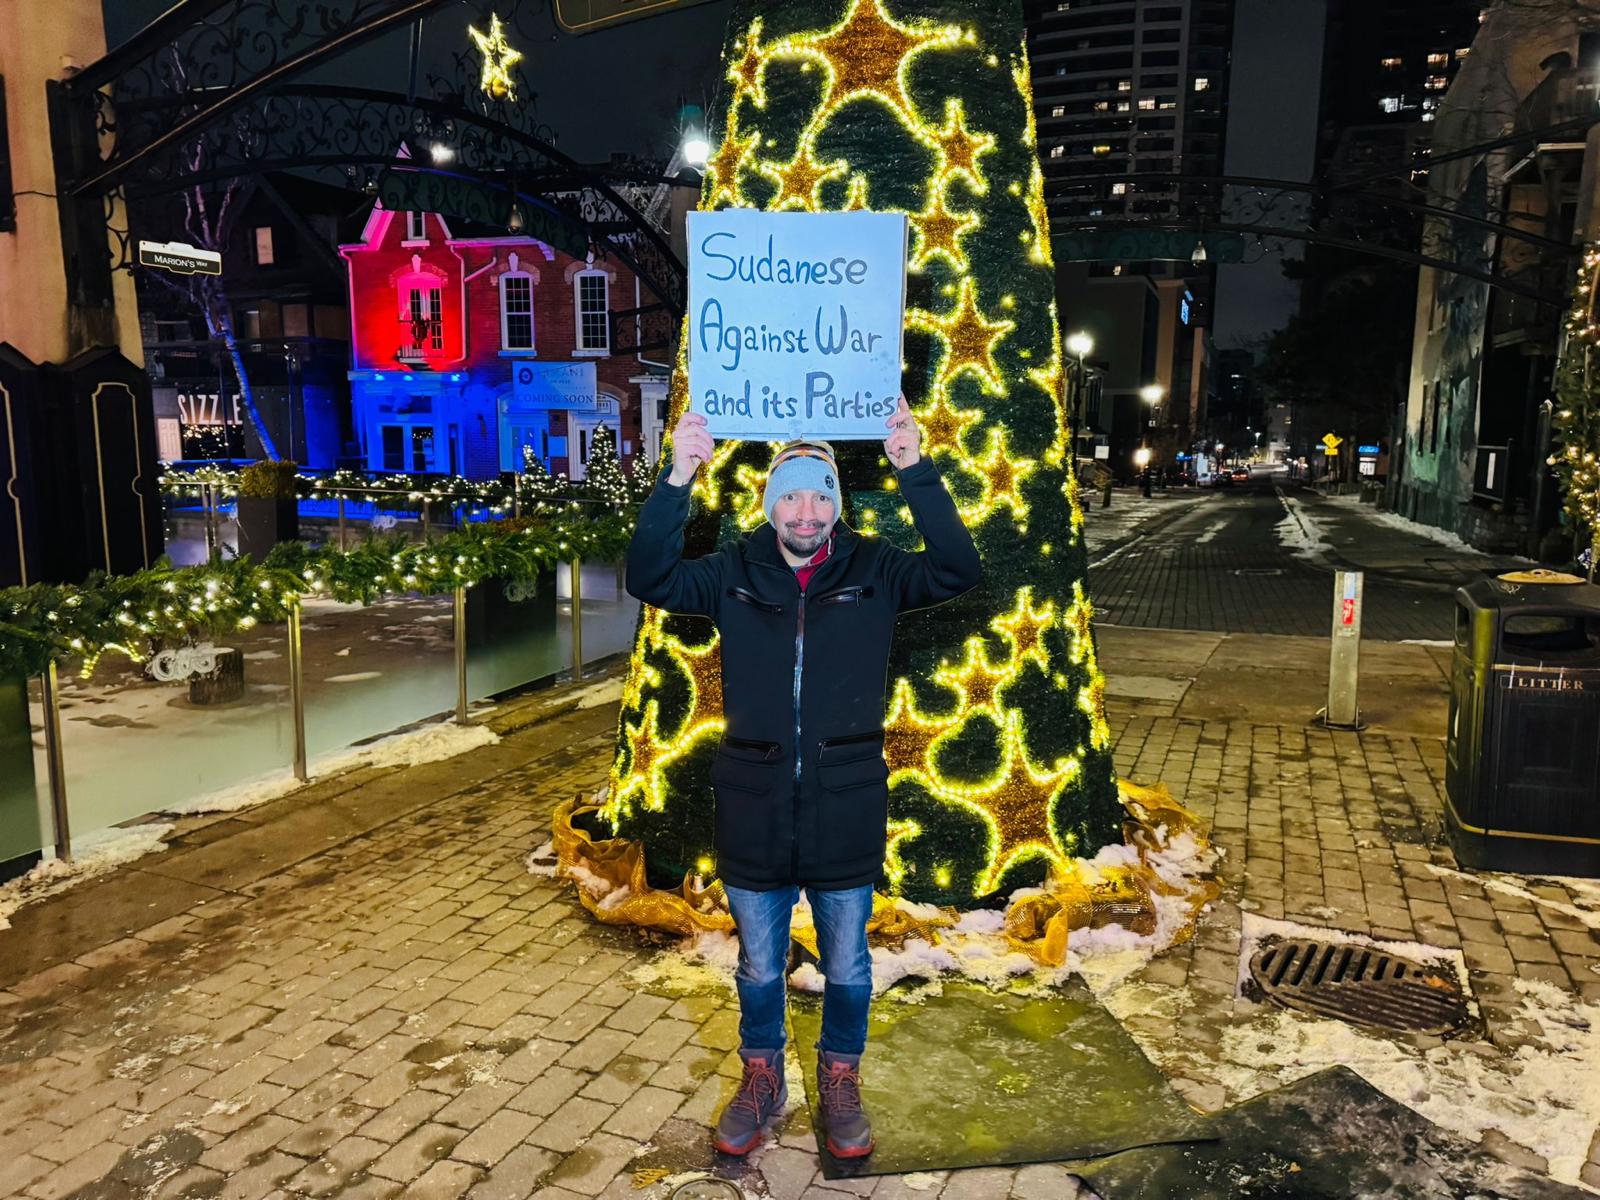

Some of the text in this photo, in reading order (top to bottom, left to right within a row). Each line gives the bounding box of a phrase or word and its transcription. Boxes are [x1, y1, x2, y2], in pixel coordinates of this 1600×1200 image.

[701, 232, 868, 285] Sudanese
[700, 297, 882, 371] Against War
[515, 393, 593, 404] COMING SOON
[704, 371, 896, 419] and its Parties
[1519, 678, 1584, 690] LITTER
